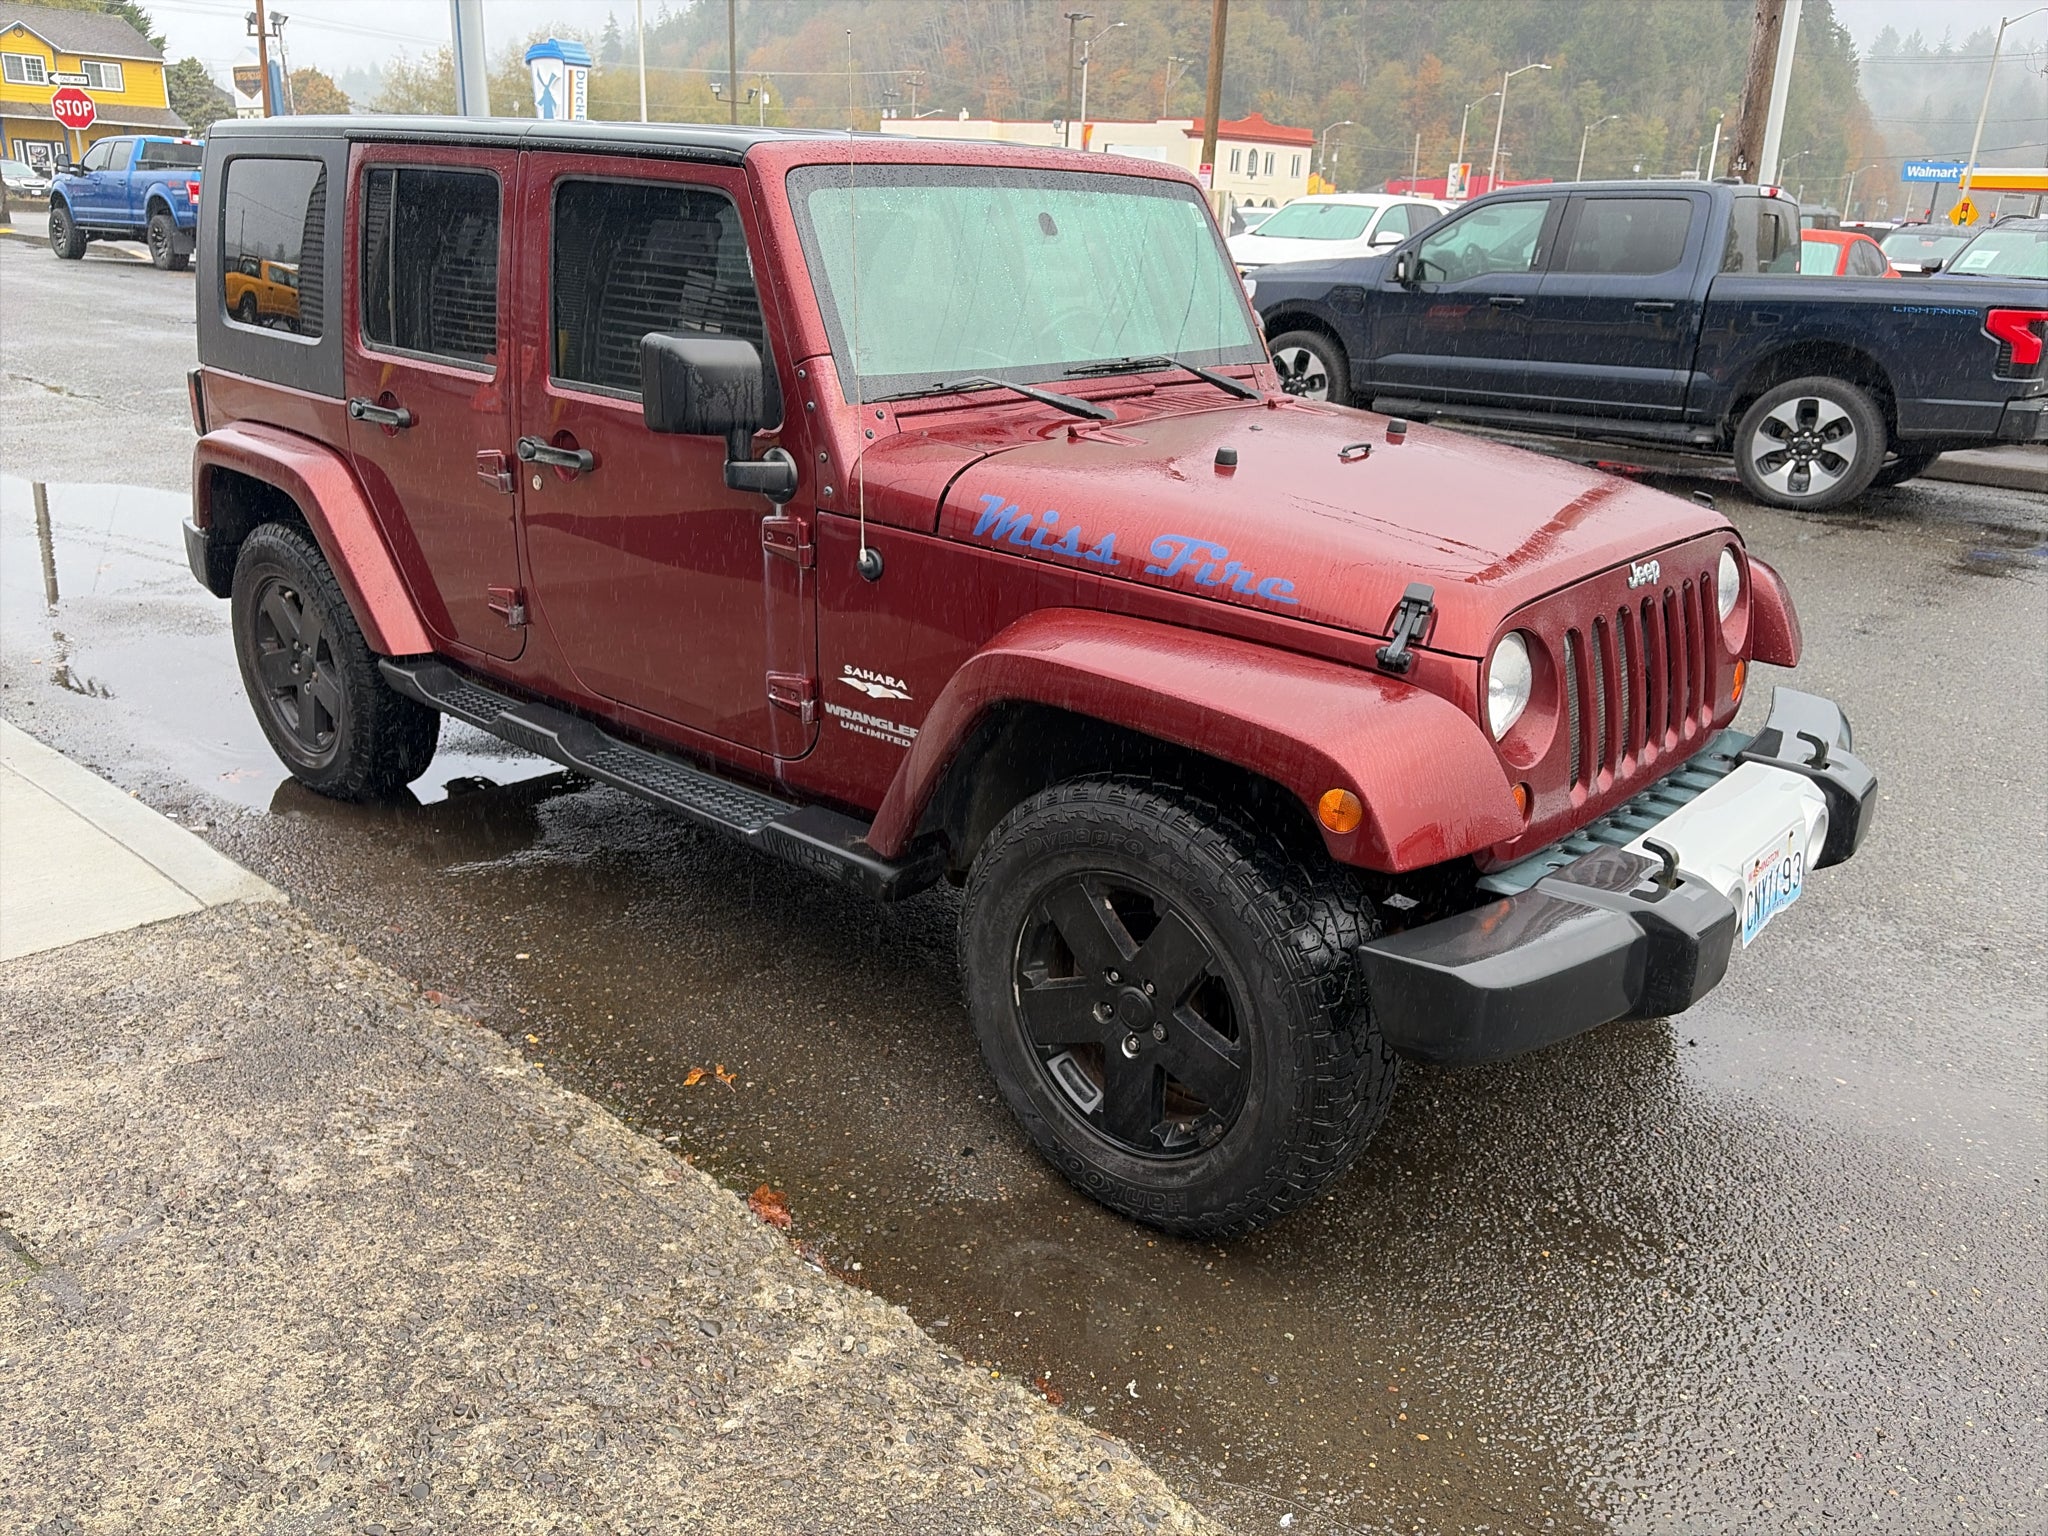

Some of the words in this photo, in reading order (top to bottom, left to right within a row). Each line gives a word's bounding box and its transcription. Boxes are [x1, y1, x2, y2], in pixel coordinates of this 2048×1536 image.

[55, 99, 92, 117] STOP
[1907, 166, 1958, 178] Walmart
[1893, 306, 1978, 315] LIGHTNING
[972, 494, 1120, 565] Miss
[1628, 560, 1660, 589] Jeep
[844, 664, 908, 690] SAHARA
[840, 720, 911, 747] UNLIMITED
[1747, 851, 1802, 931] CNY1193
